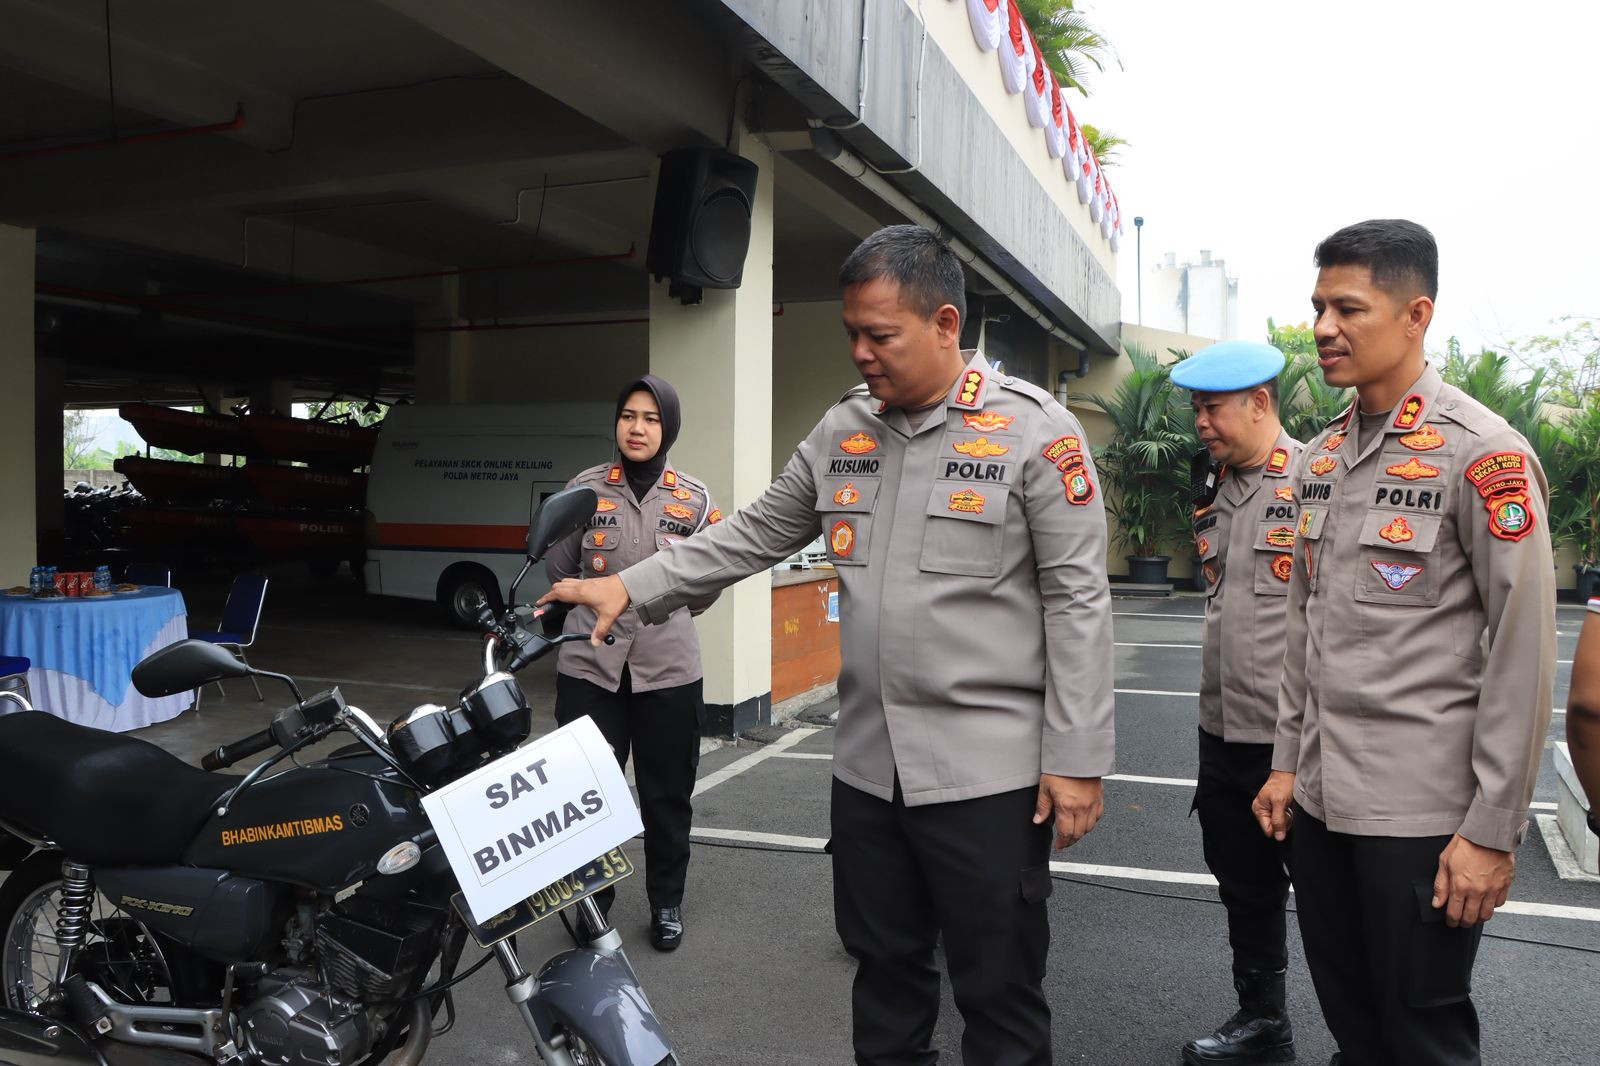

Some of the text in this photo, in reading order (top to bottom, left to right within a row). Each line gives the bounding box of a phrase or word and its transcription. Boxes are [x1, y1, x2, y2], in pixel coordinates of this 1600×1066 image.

[306, 424, 350, 438] POLISI
[414, 459, 553, 470] PELAYANAN SKCK ONLINE KELILING
[829, 459, 880, 473] KUSUMO
[945, 461, 1006, 481] POLRI
[1470, 458, 1495, 477] POLRES
[1474, 461, 1521, 481] BEKASI KOTA
[443, 472, 519, 481] POLDA METRO JAYA
[1483, 481, 1506, 493] METRO
[1375, 487, 1442, 510] POLRI
[299, 523, 344, 534] POLISI
[485, 758, 548, 809] SAT
[221, 815, 343, 846] BHABINKAMTIBMAS
[473, 789, 603, 875] BINMAS
